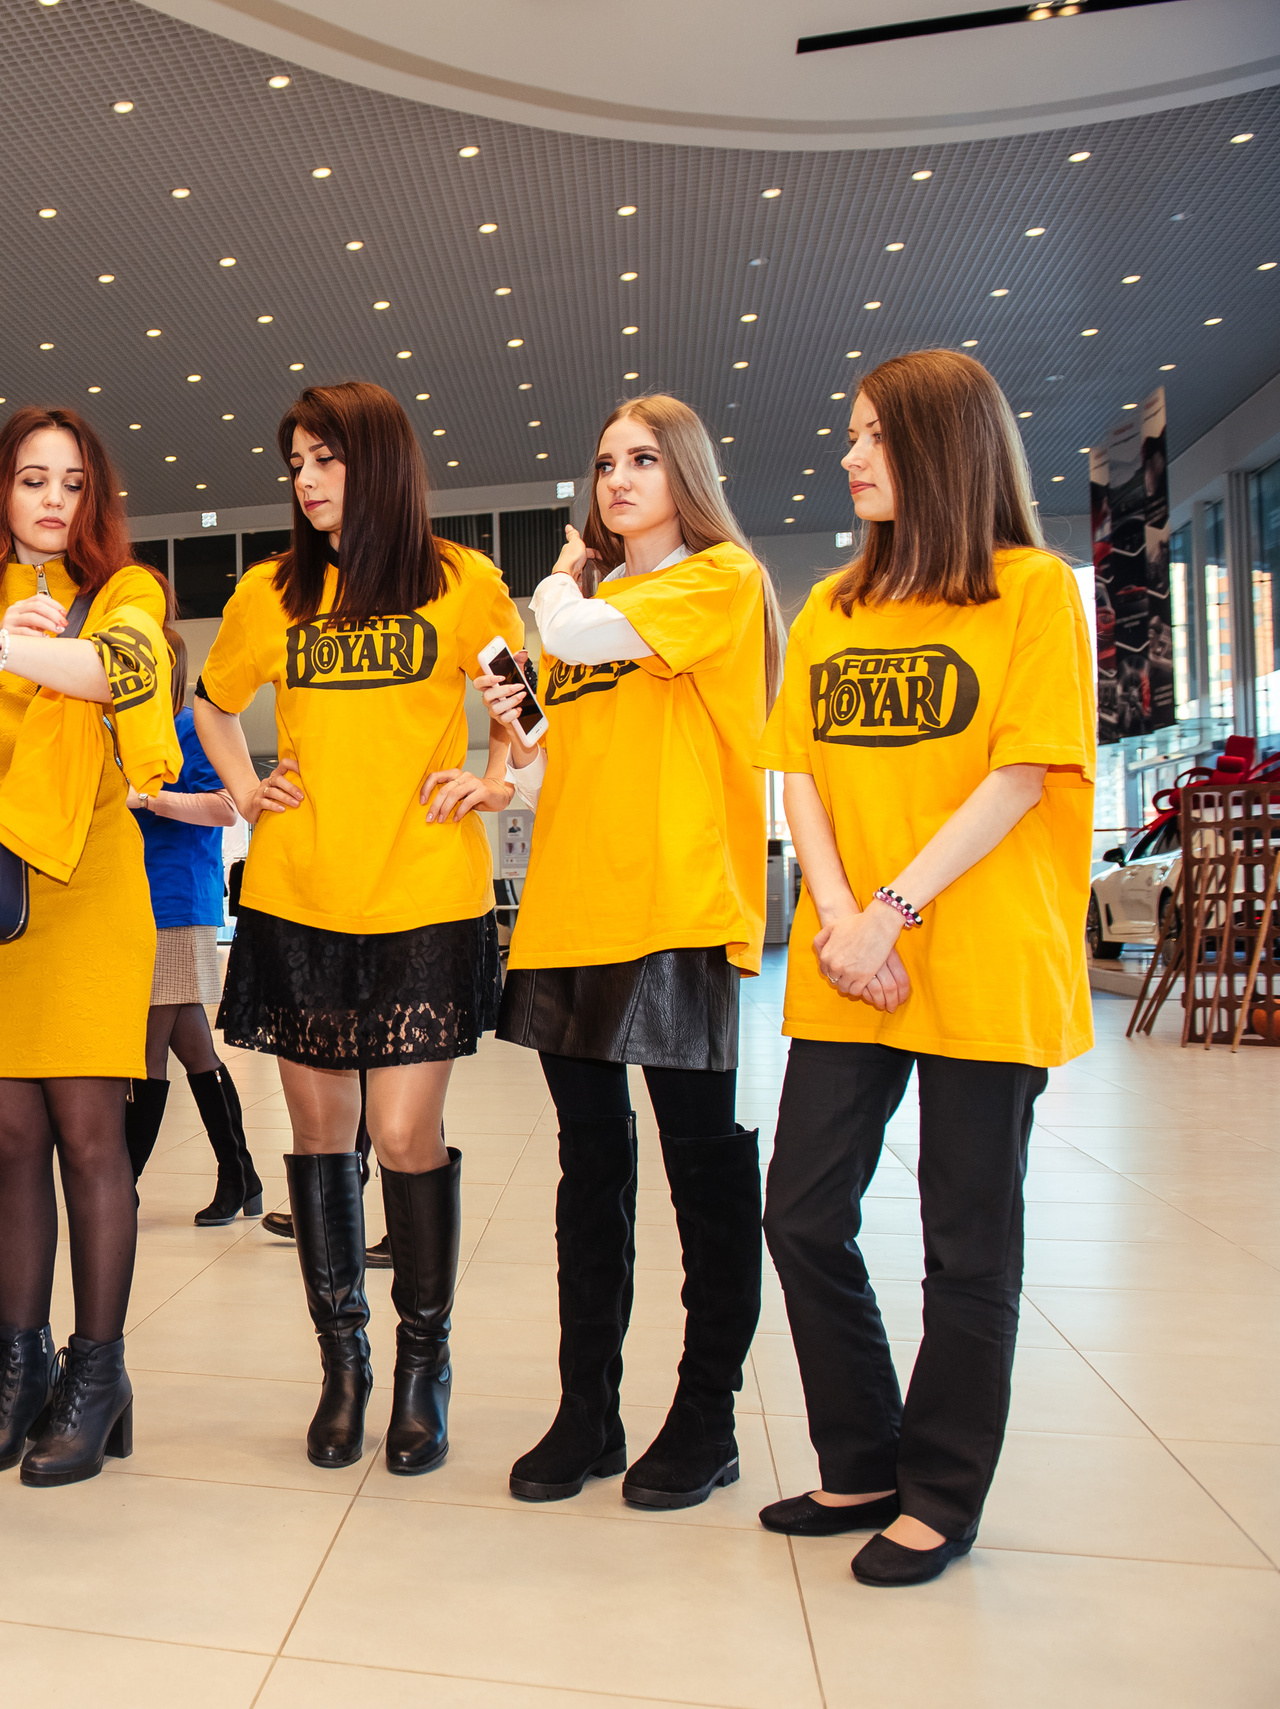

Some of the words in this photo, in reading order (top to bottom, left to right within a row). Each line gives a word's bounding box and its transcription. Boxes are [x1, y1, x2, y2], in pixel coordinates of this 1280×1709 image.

[286, 617, 438, 690] BOYARD
[841, 655, 924, 676] FORT
[810, 650, 980, 744] BOYARD
